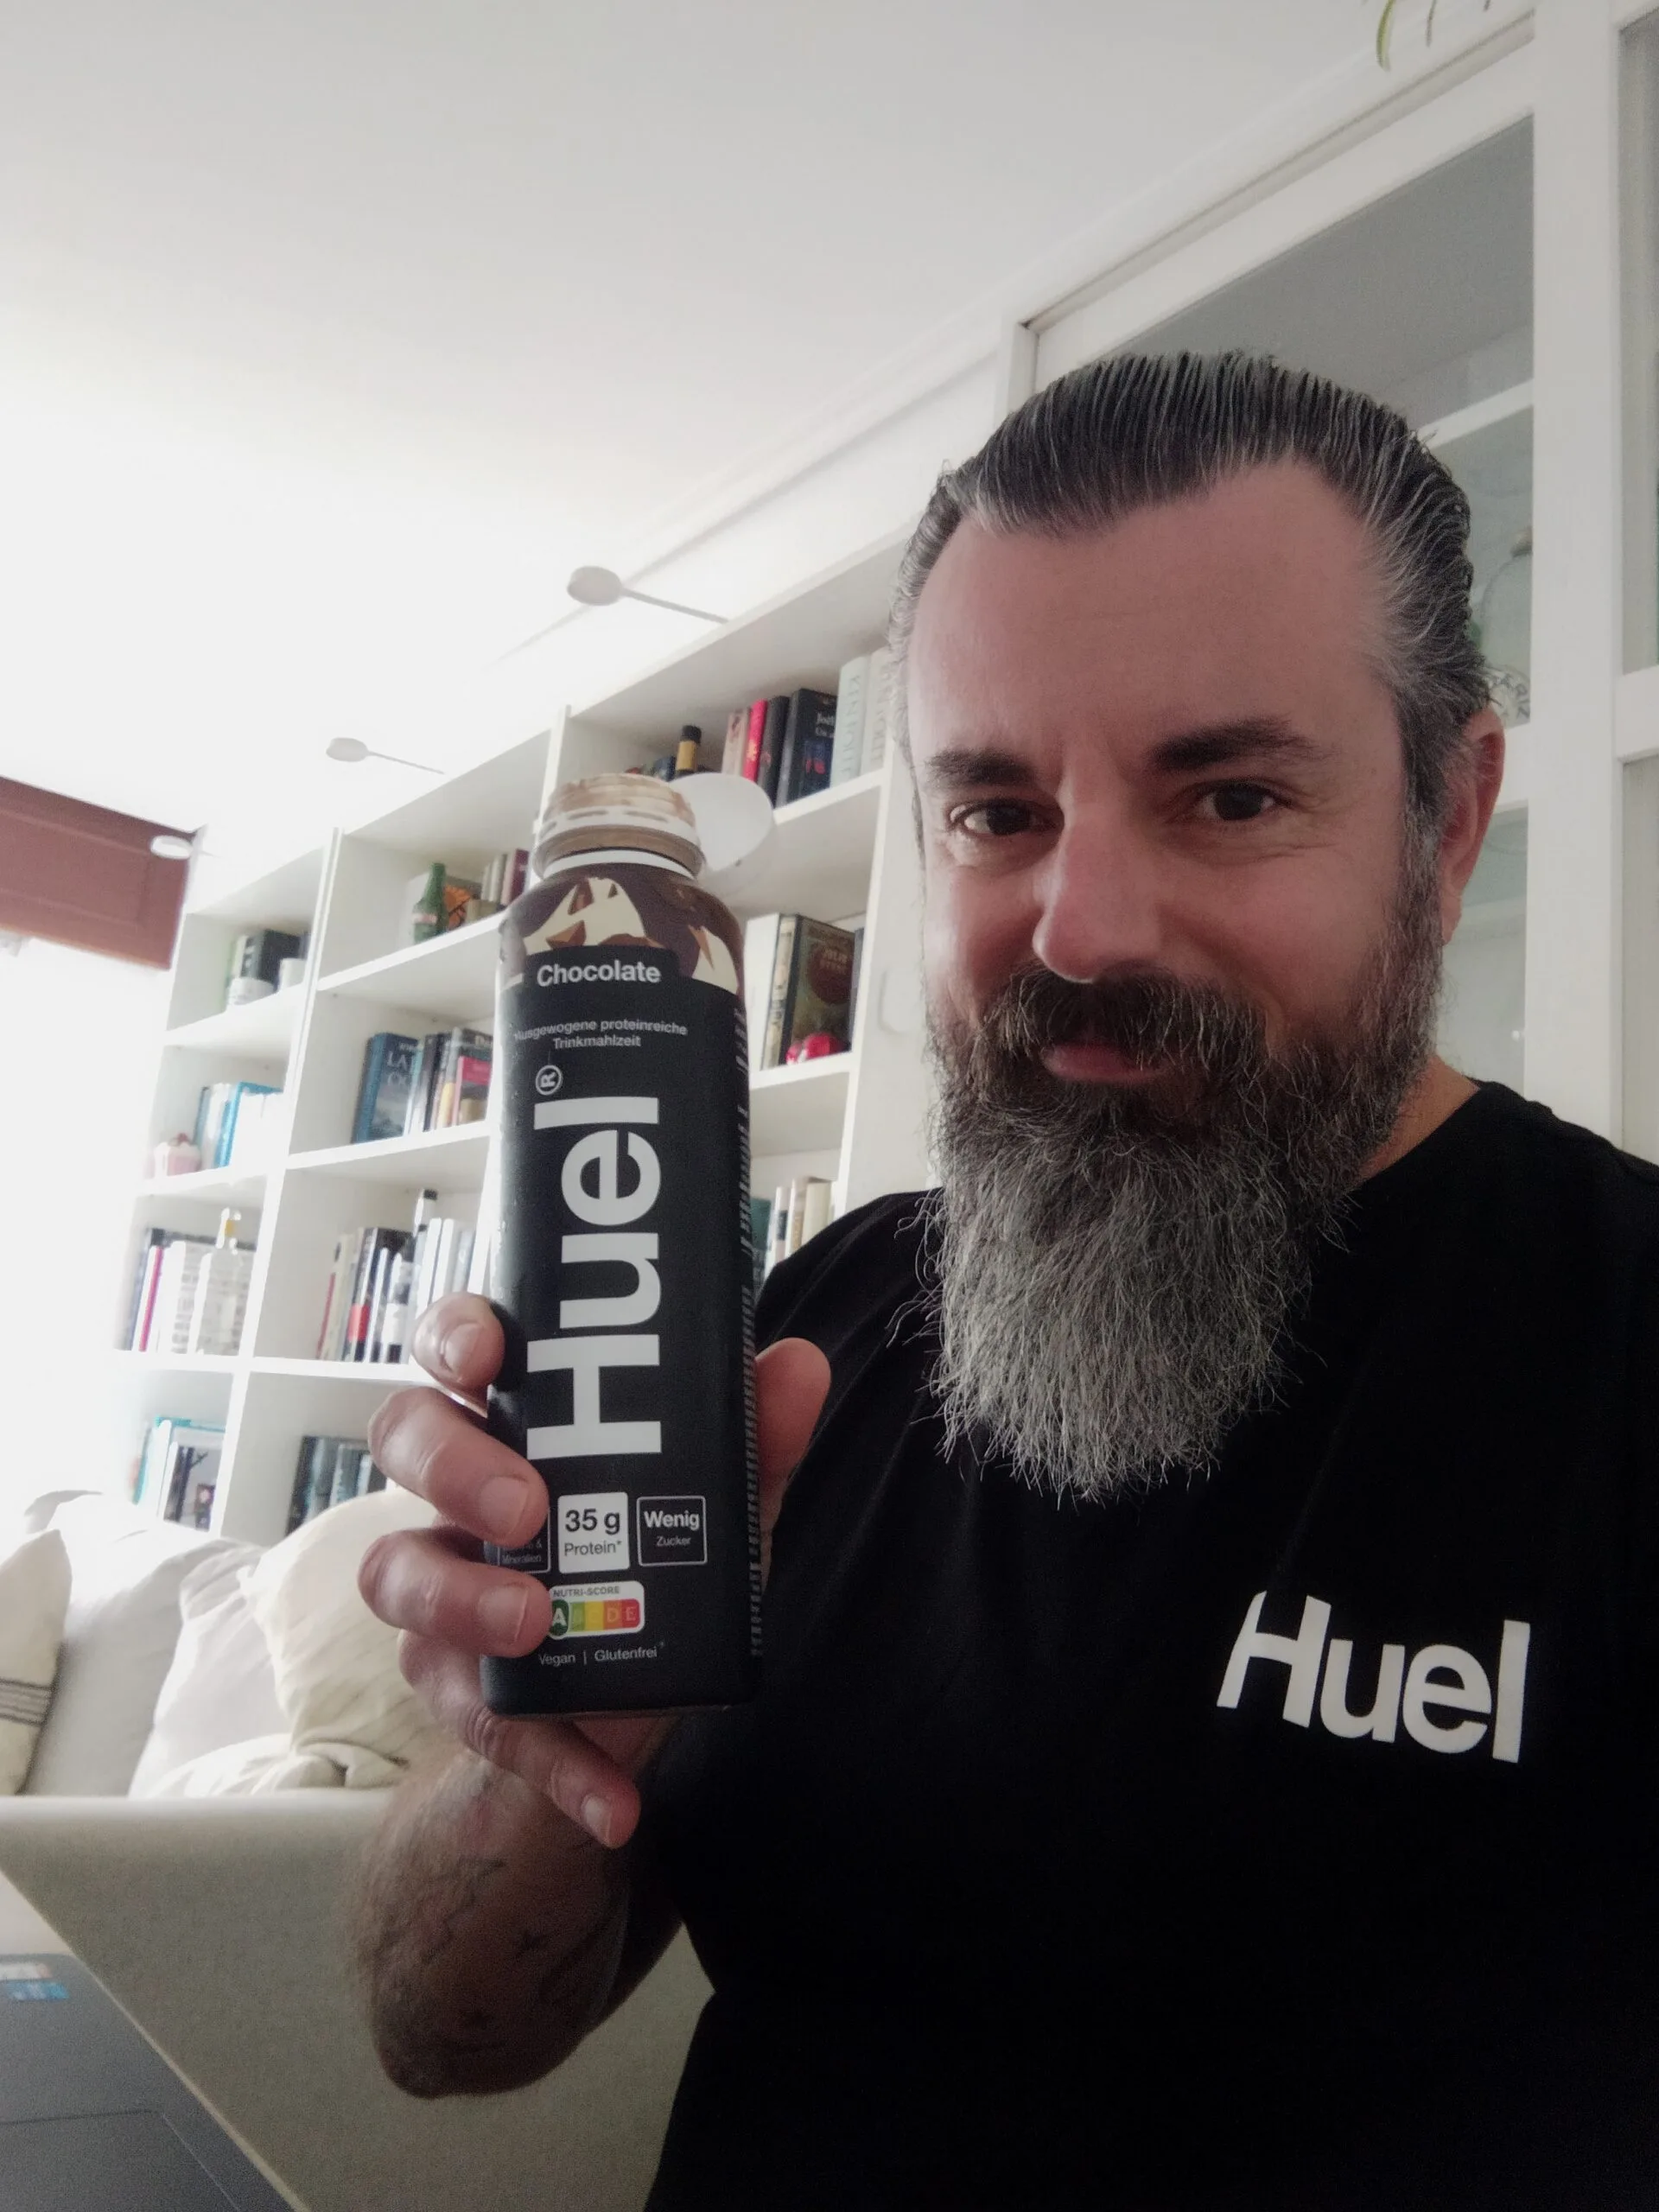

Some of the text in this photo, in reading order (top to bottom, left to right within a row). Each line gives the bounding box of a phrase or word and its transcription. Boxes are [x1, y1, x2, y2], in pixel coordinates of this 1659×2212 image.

[537, 959, 662, 987] Chocolate
[601, 1019, 688, 1035] proteinreiche
[553, 1035, 641, 1049] Trinkmahlzeit
[526, 1096, 662, 1460] Huel
[565, 1509, 620, 1535] 35 g
[644, 1510, 700, 1531] Wenig
[656, 1535, 691, 1548] Zucker
[539, 1654, 575, 1667] Vegan
[1217, 1590, 1530, 1764] Huel
